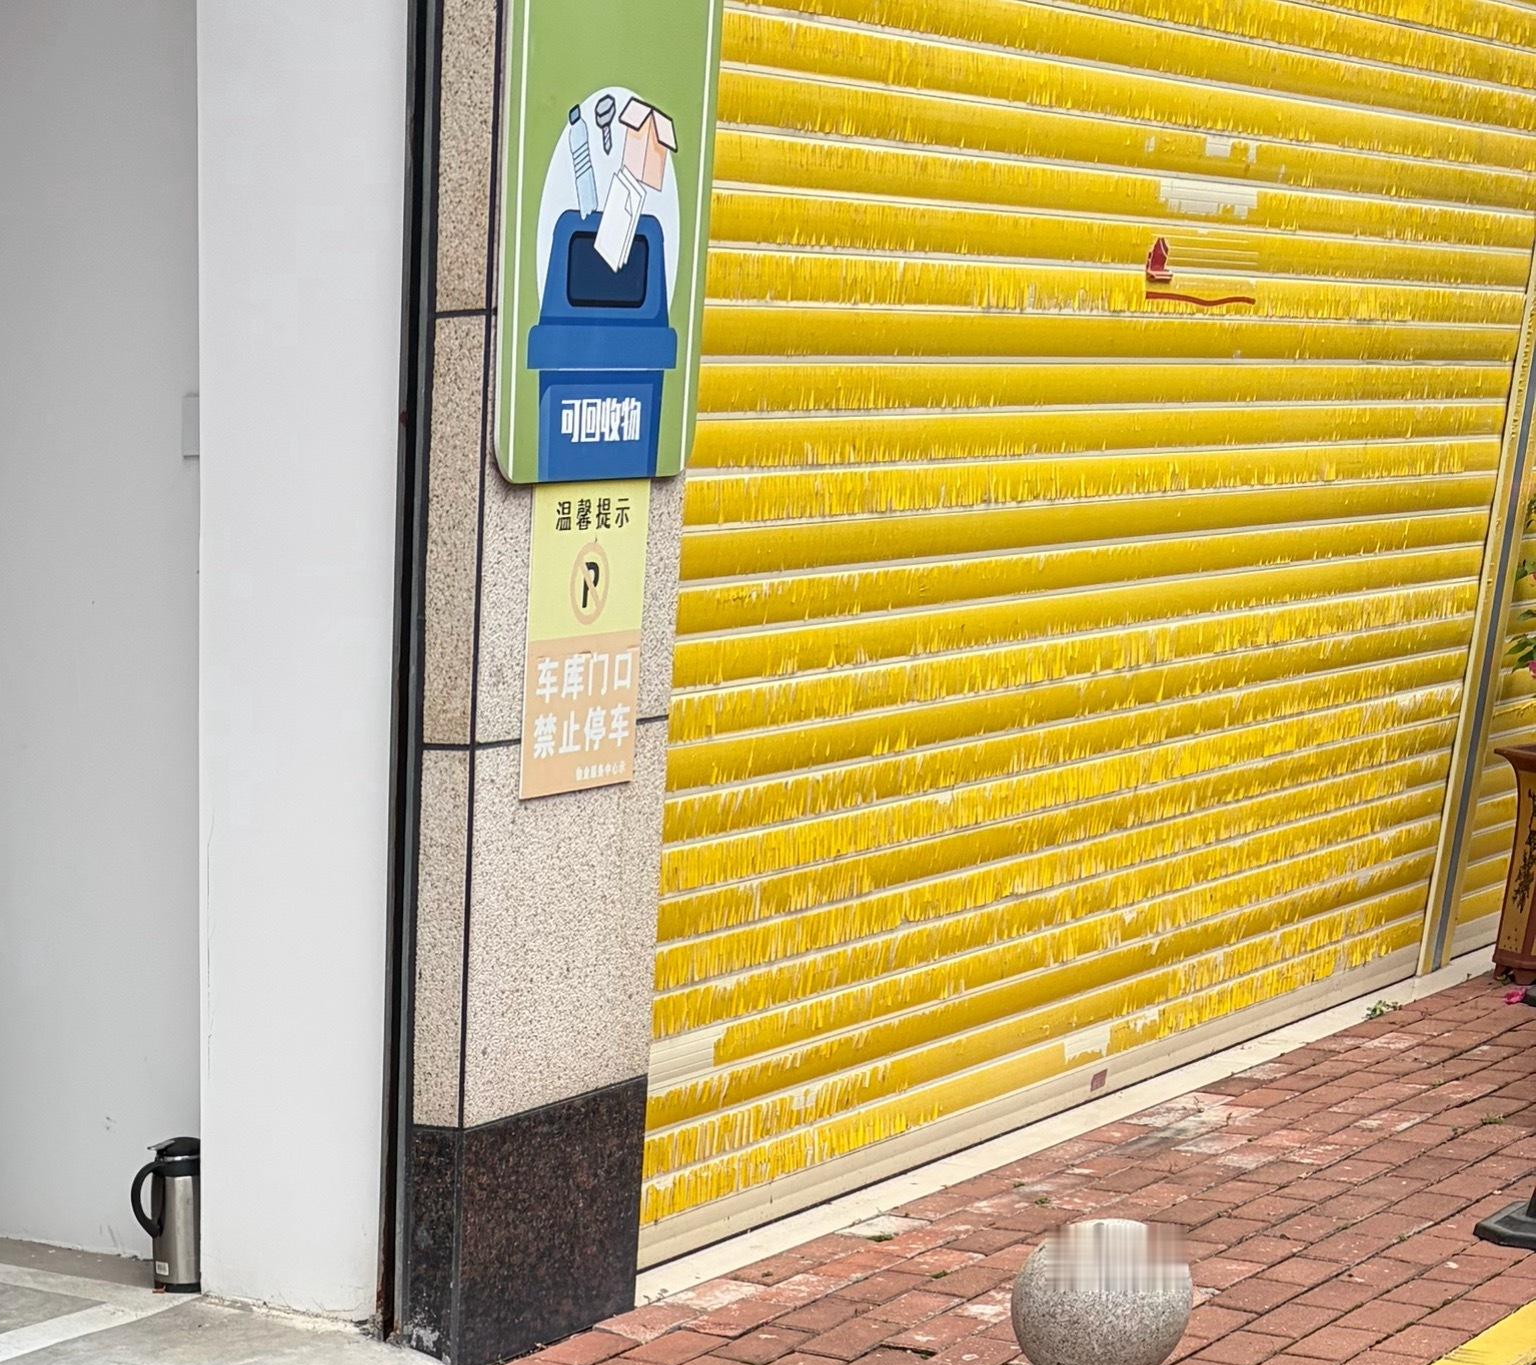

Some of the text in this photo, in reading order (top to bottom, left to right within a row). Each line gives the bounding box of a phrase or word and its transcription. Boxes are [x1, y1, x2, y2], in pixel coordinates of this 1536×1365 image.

[561, 397, 641, 443] 可回收物
[555, 497, 630, 531] 温馨提示
[536, 652, 632, 704] 车库门口
[533, 703, 631, 759] 禁止停车
